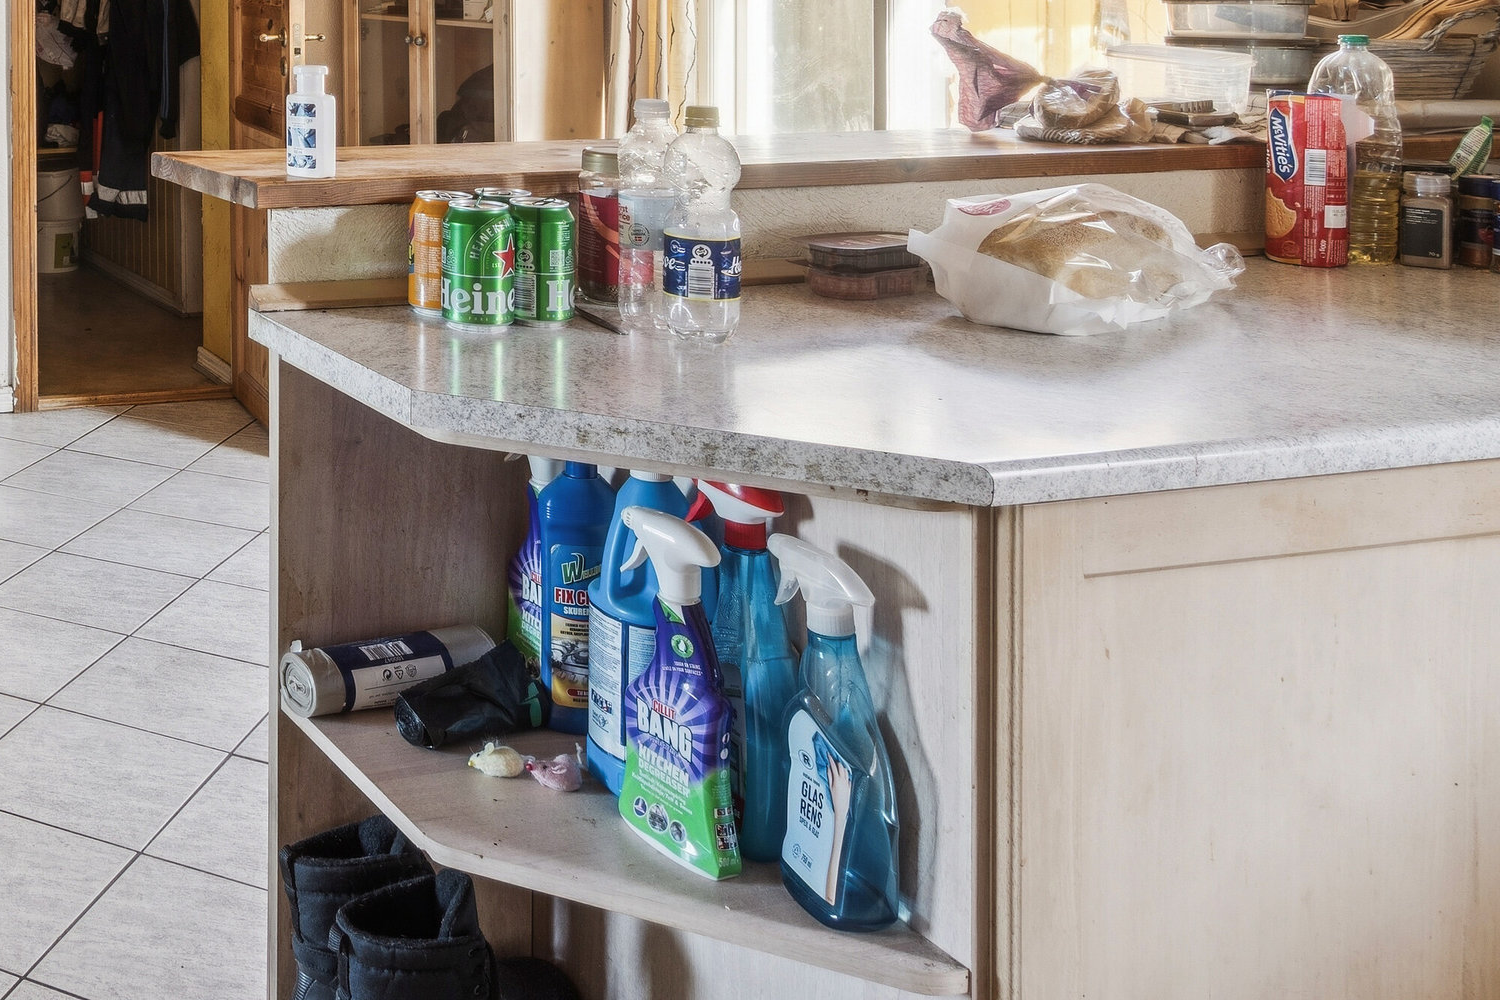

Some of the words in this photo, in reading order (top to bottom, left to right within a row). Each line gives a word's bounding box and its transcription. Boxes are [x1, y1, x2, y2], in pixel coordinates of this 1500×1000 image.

[1270, 116, 1292, 174] McVitie's
[469, 217, 512, 260] HEINEKEN
[555, 587, 575, 605] FIX
[653, 699, 676, 720] CILLIT
[636, 697, 693, 763] BANG
[638, 743, 690, 788] KITCHEN
[638, 758, 691, 798] DEGREASER
[800, 798, 823, 830] RENS
[801, 780, 824, 810] GLAS
